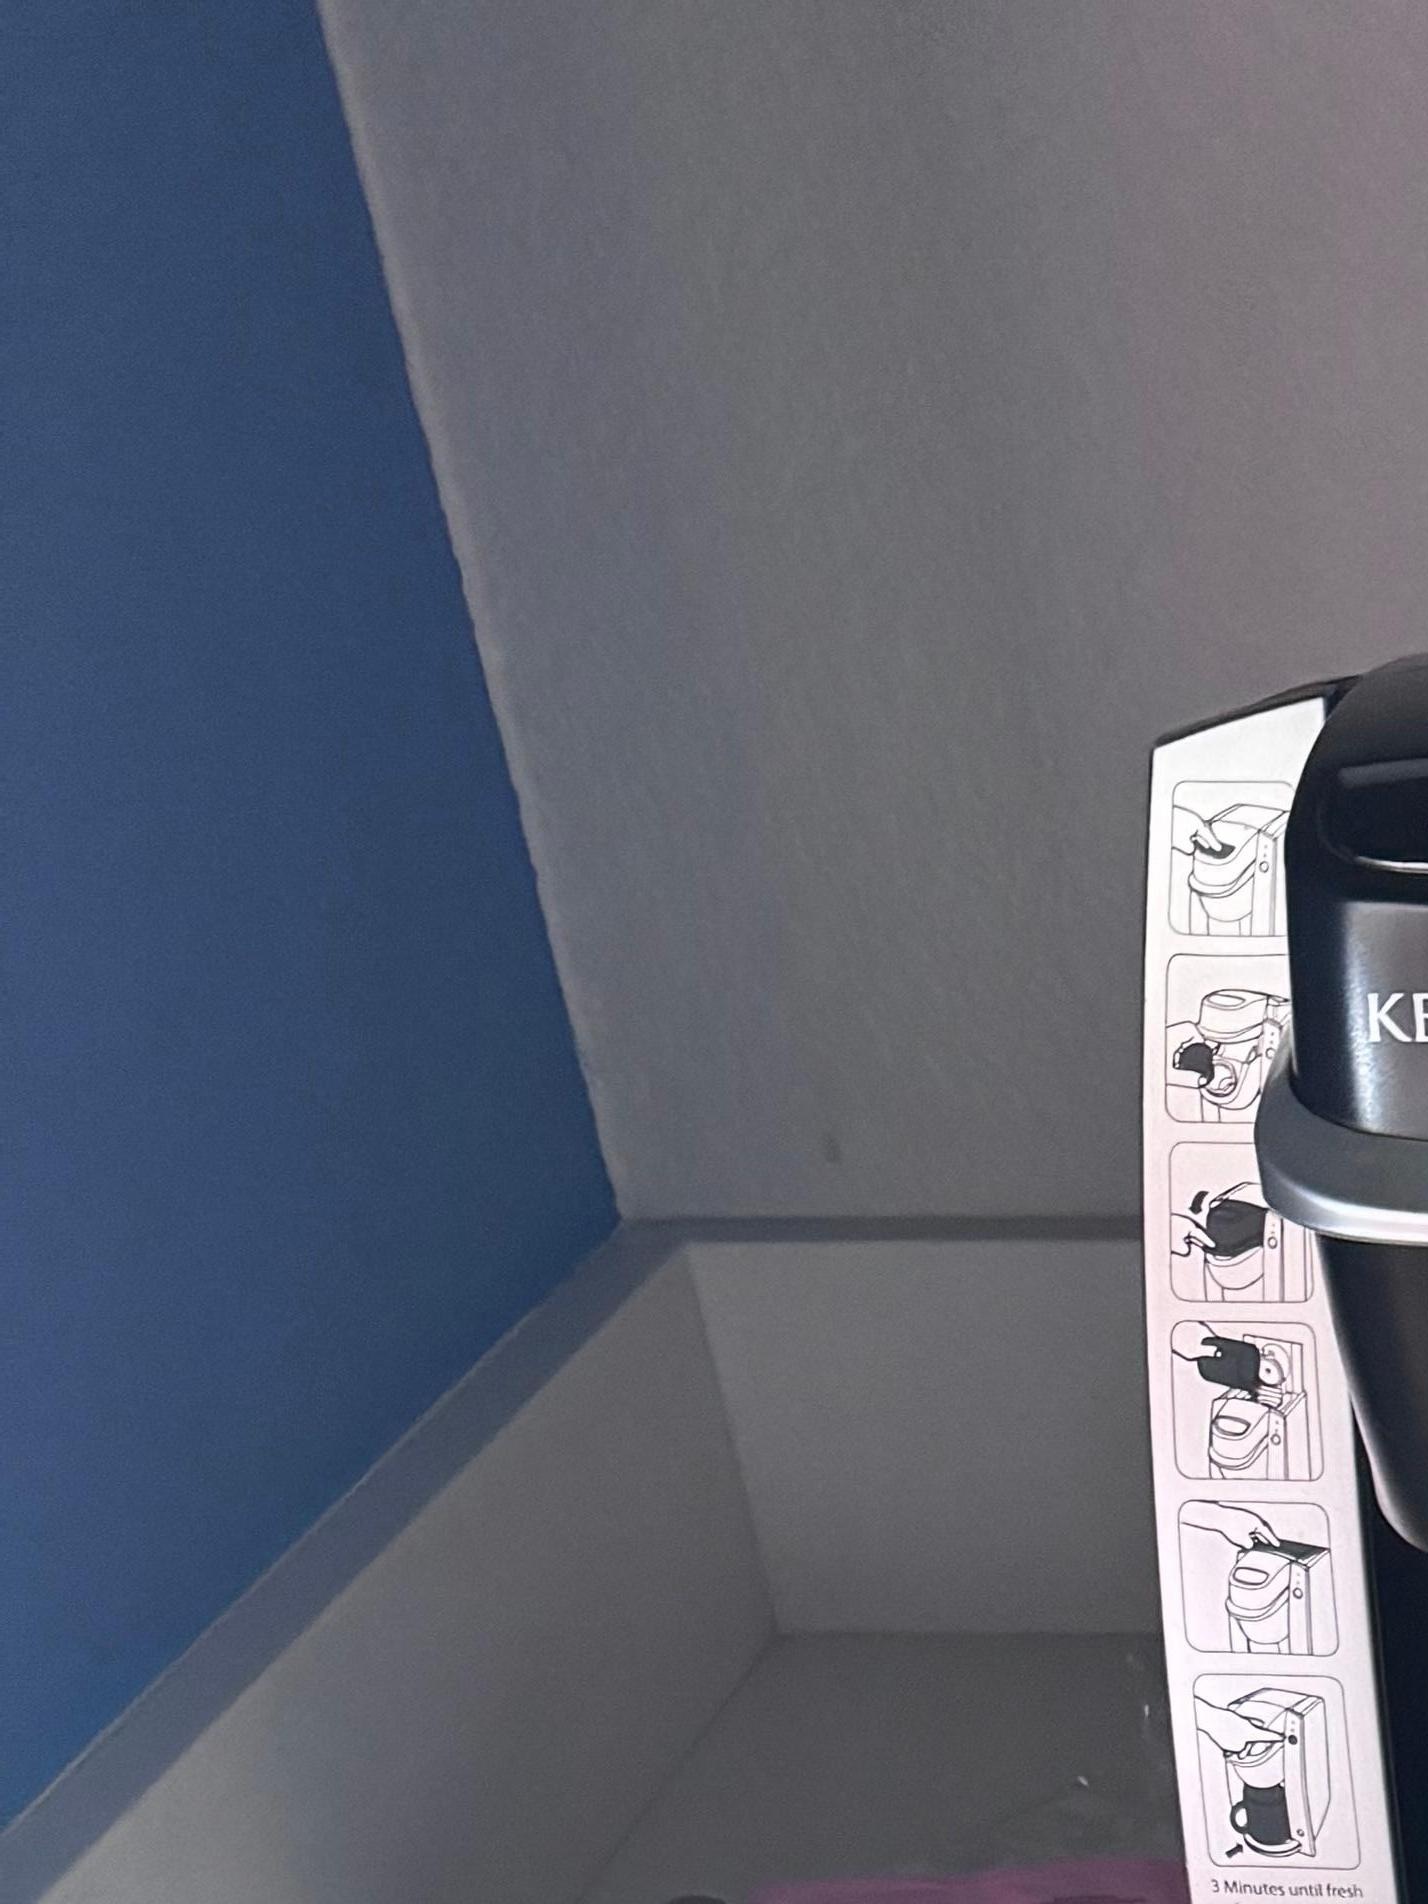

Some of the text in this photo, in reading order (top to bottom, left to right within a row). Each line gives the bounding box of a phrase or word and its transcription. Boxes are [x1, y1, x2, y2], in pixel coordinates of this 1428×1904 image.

[1211, 1879, 1364, 1898] 3 Minutes until fresh
